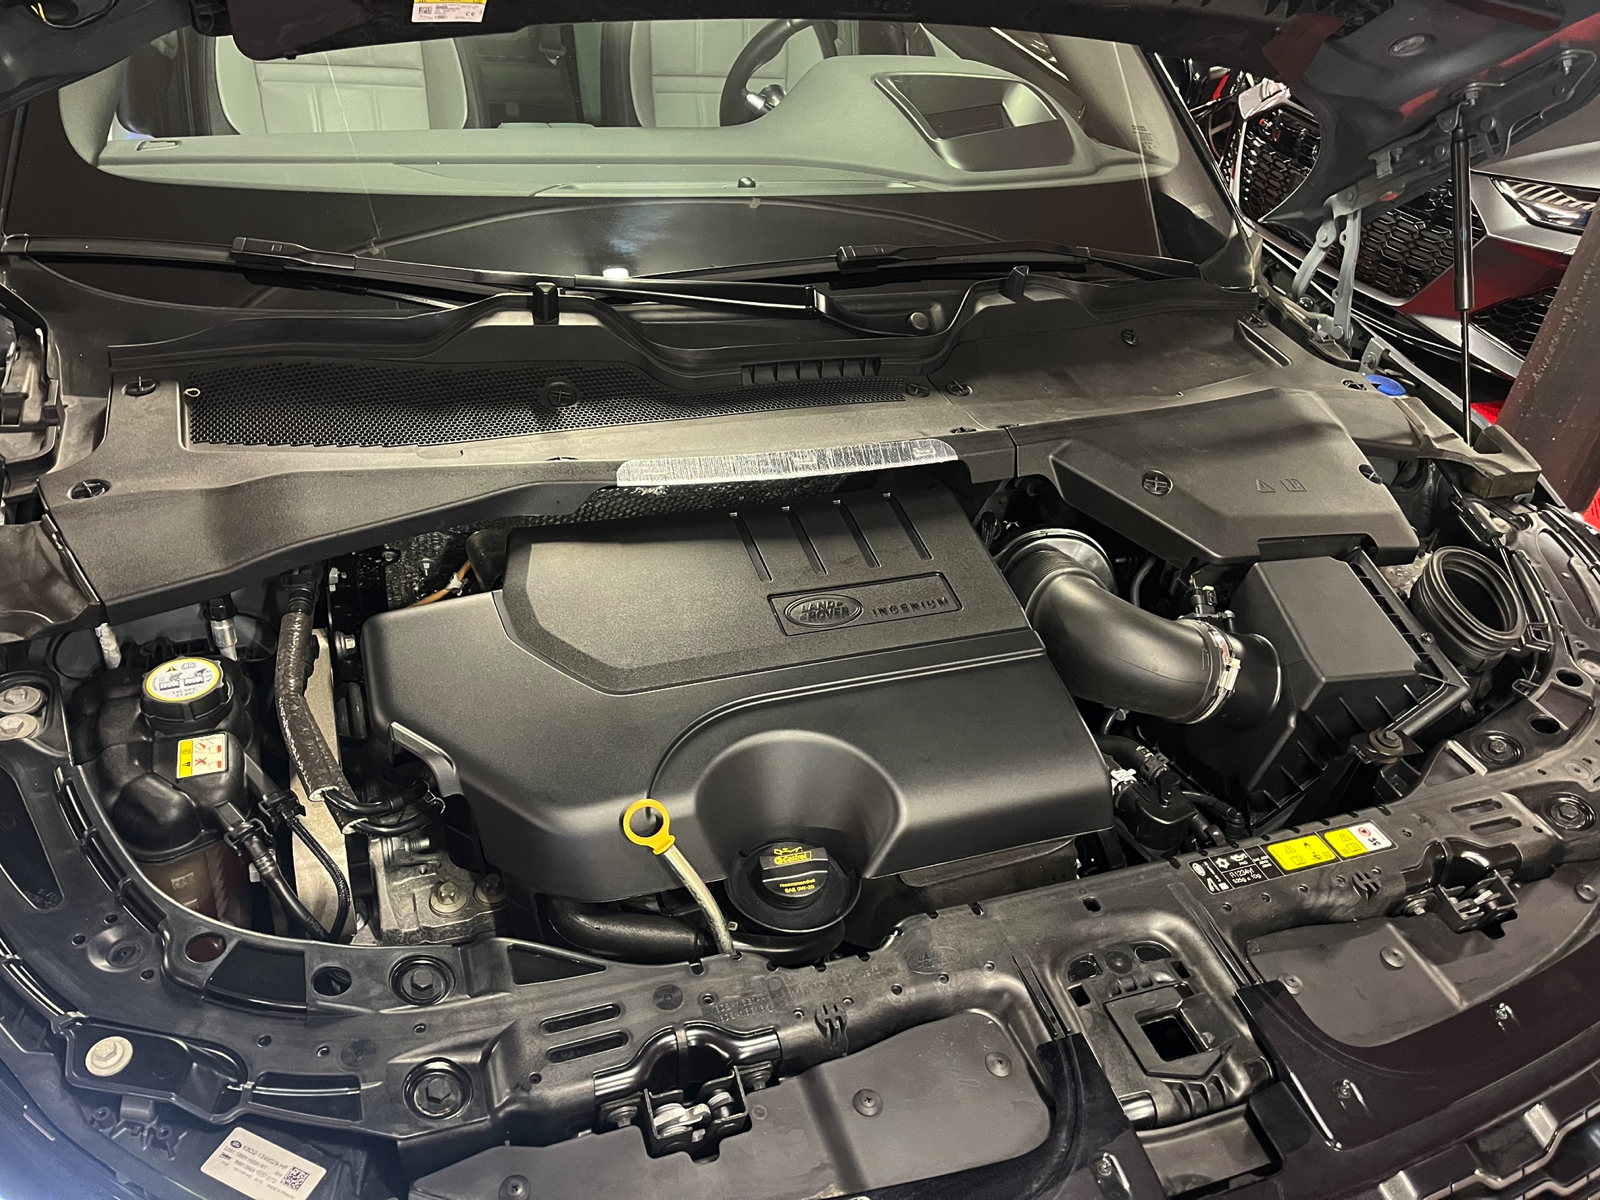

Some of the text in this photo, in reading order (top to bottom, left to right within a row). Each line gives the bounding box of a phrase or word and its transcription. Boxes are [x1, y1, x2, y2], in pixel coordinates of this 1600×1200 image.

[801, 600, 838, 613] LAND
[872, 597, 949, 618] INGENIUM
[808, 606, 850, 623] ROVER
[783, 852, 807, 864] Castrol
[779, 878, 815, 886] recommended
